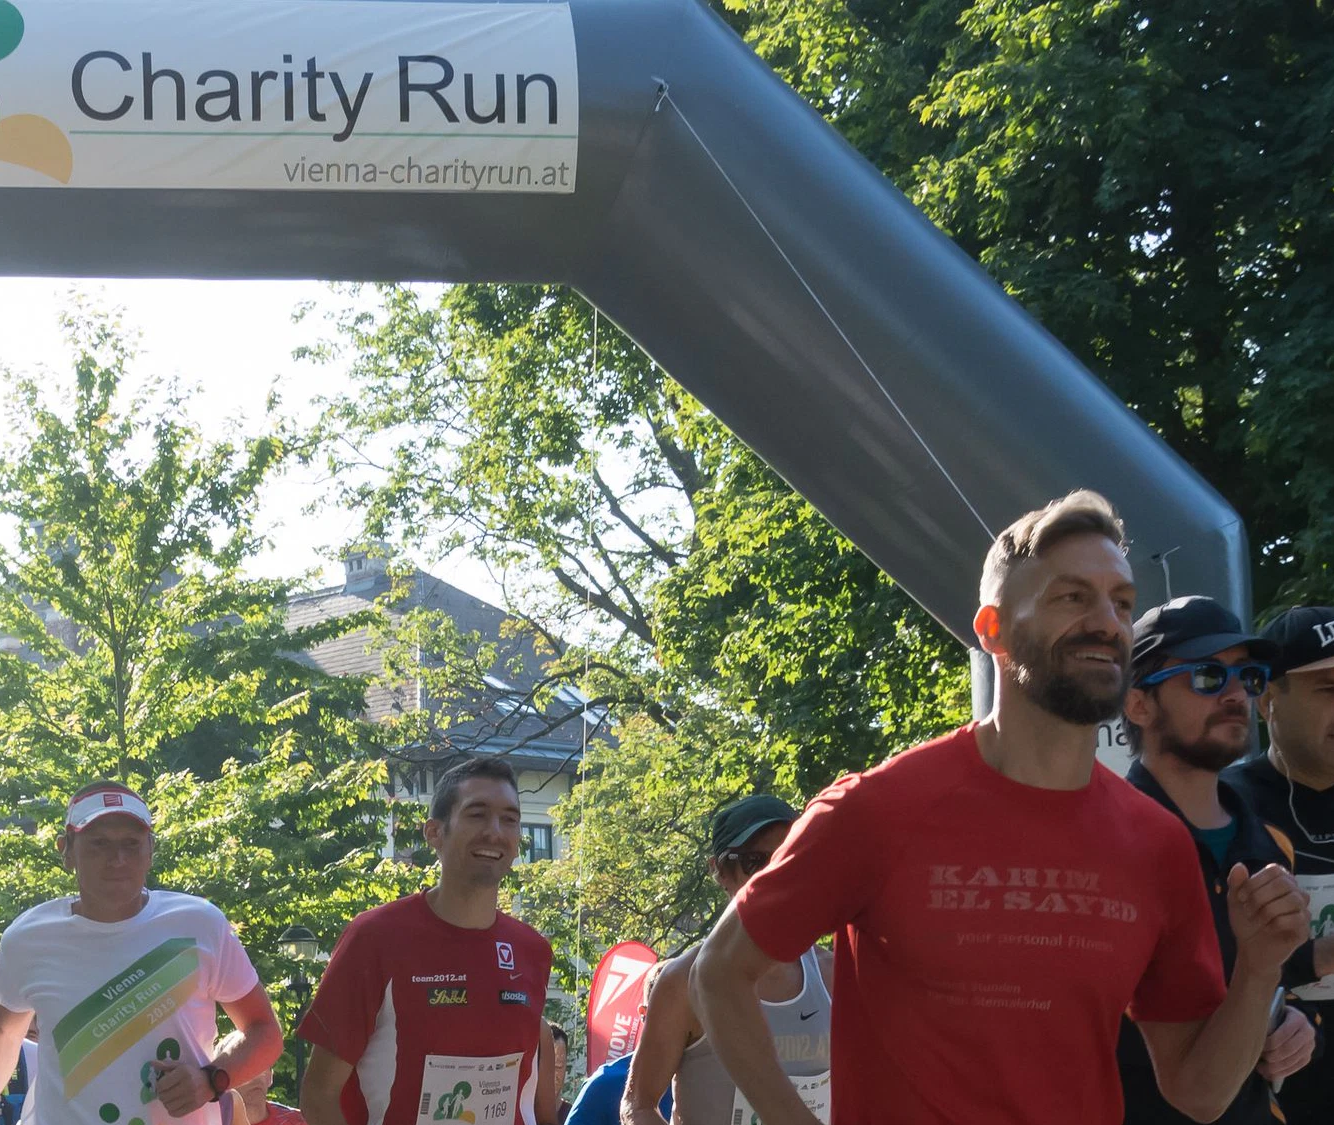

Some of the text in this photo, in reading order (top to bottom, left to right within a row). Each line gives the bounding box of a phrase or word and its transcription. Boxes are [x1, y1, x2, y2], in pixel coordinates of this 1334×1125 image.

[70, 48, 557, 141] Charity Run
[283, 153, 570, 191] vienna-charityrun.at
[928, 865, 1101, 892] KARIM
[926, 889, 1139, 924] EL SAYED
[102, 968, 146, 1001] Vienna
[411, 973, 467, 983] team2012.at
[92, 981, 162, 1038] Charity Run
[481, 1087, 502, 1096] Charity
[484, 1101, 507, 1120] 1169
